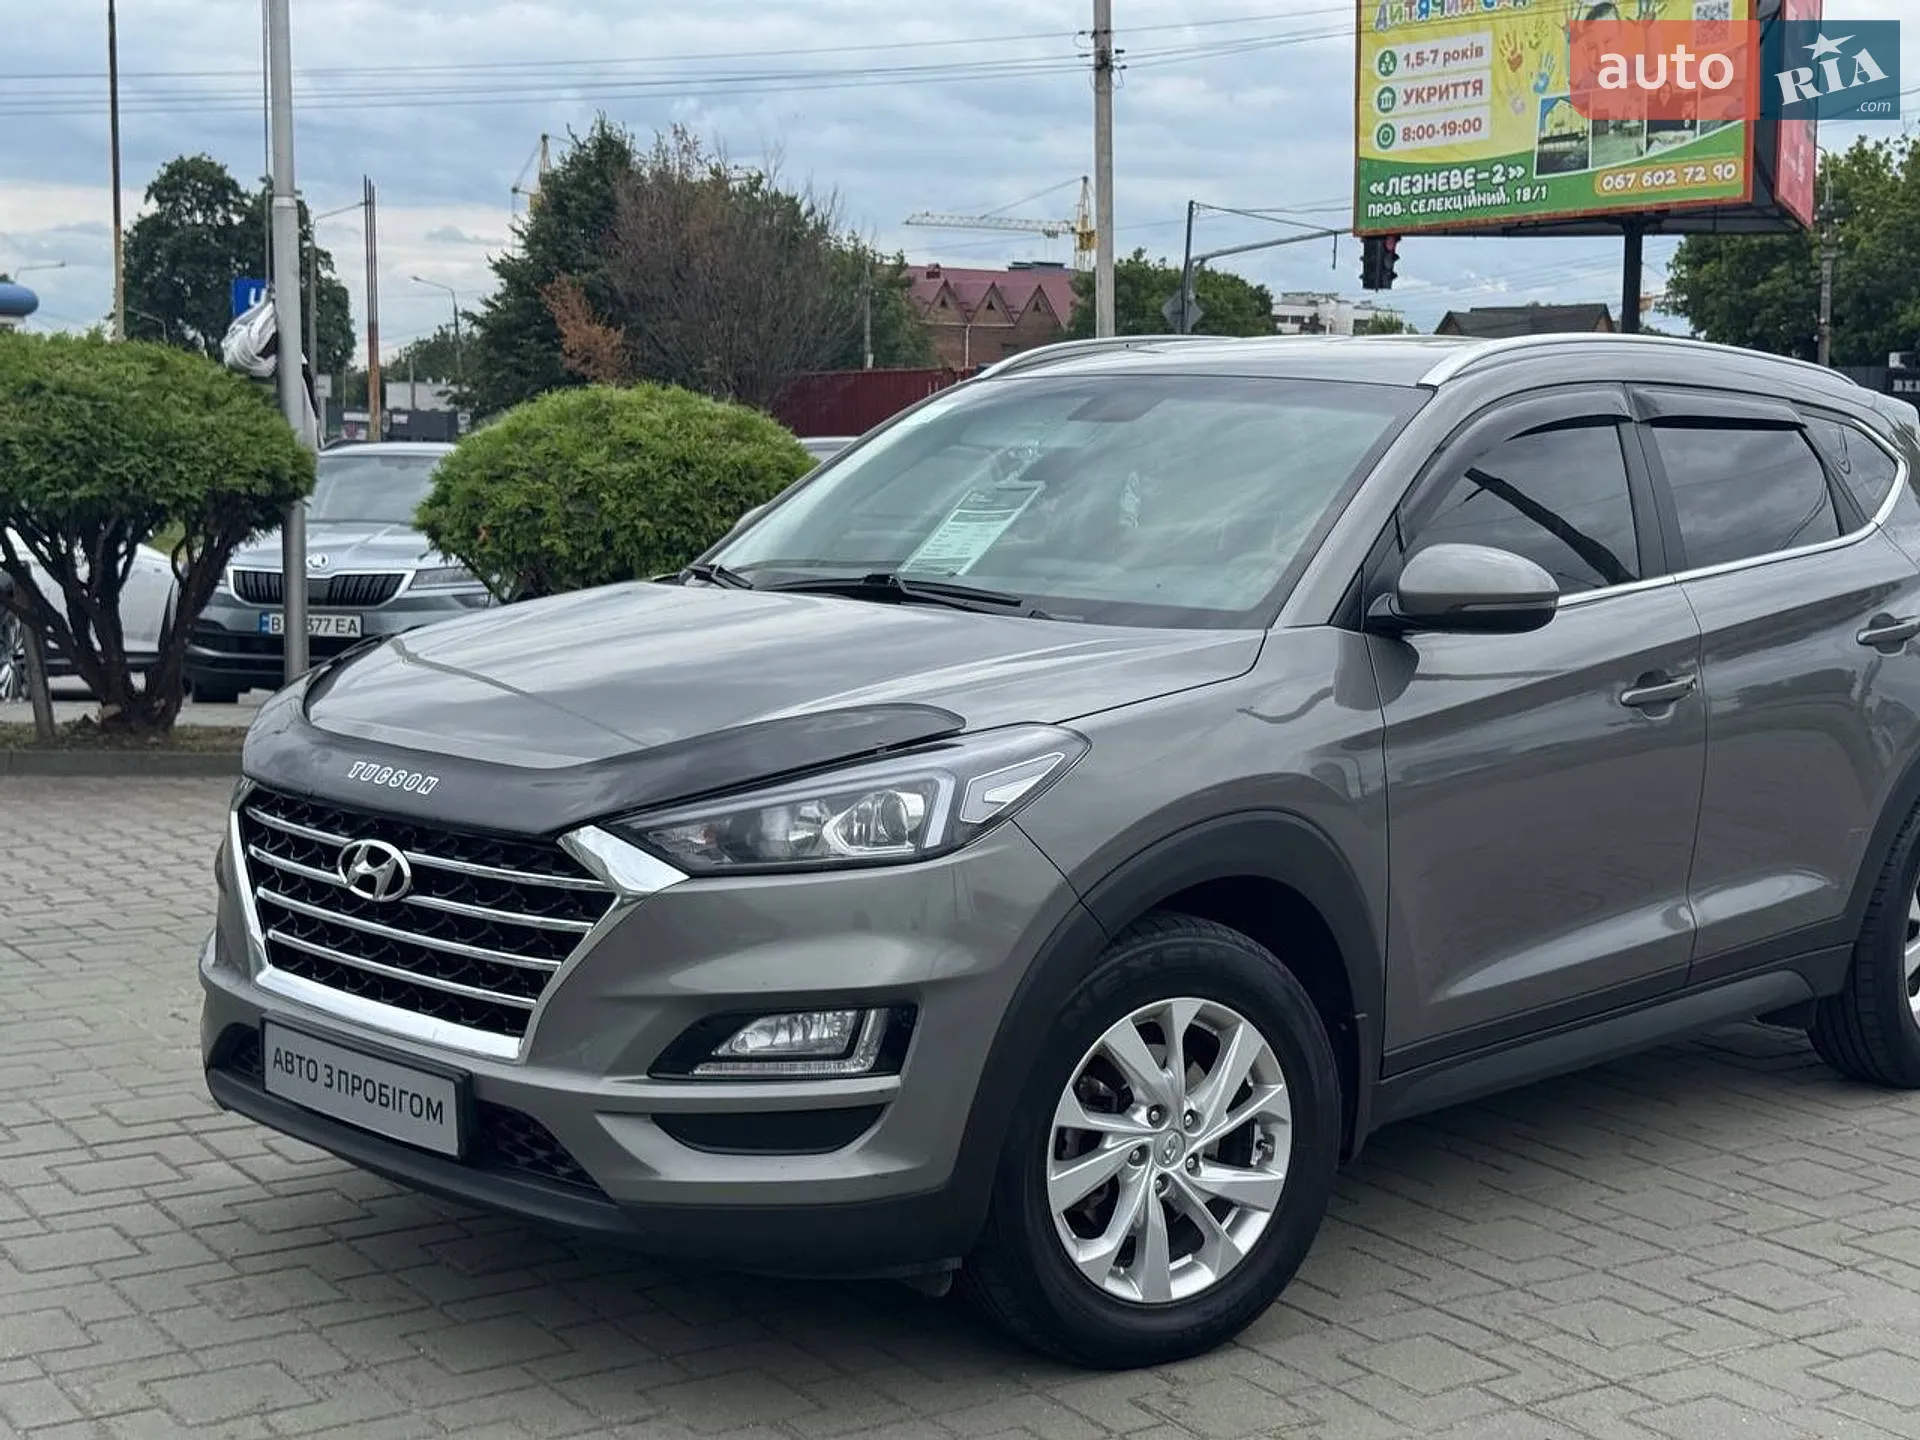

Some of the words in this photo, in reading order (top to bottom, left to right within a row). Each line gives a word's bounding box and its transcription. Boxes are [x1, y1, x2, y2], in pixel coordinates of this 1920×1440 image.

[1403, 49, 1439, 69] 1,5-7
[1442, 42, 1484, 67] років
[1403, 79, 1484, 105] УКРИТТЯ
[1402, 117, 1483, 142] 8:00-19:00
[1602, 172, 1636, 191] 067
[1642, 168, 1677, 188] 602
[1684, 166, 1707, 183] 72
[1713, 163, 1737, 181] 90
[1367, 201, 1407, 218] ПРОВ.
[1515, 184, 1547, 202] 18/1
[347, 761, 440, 795] TUCSON
[273, 1047, 319, 1083] АВТО
[337, 1070, 444, 1125] ПРОБІГОМ
